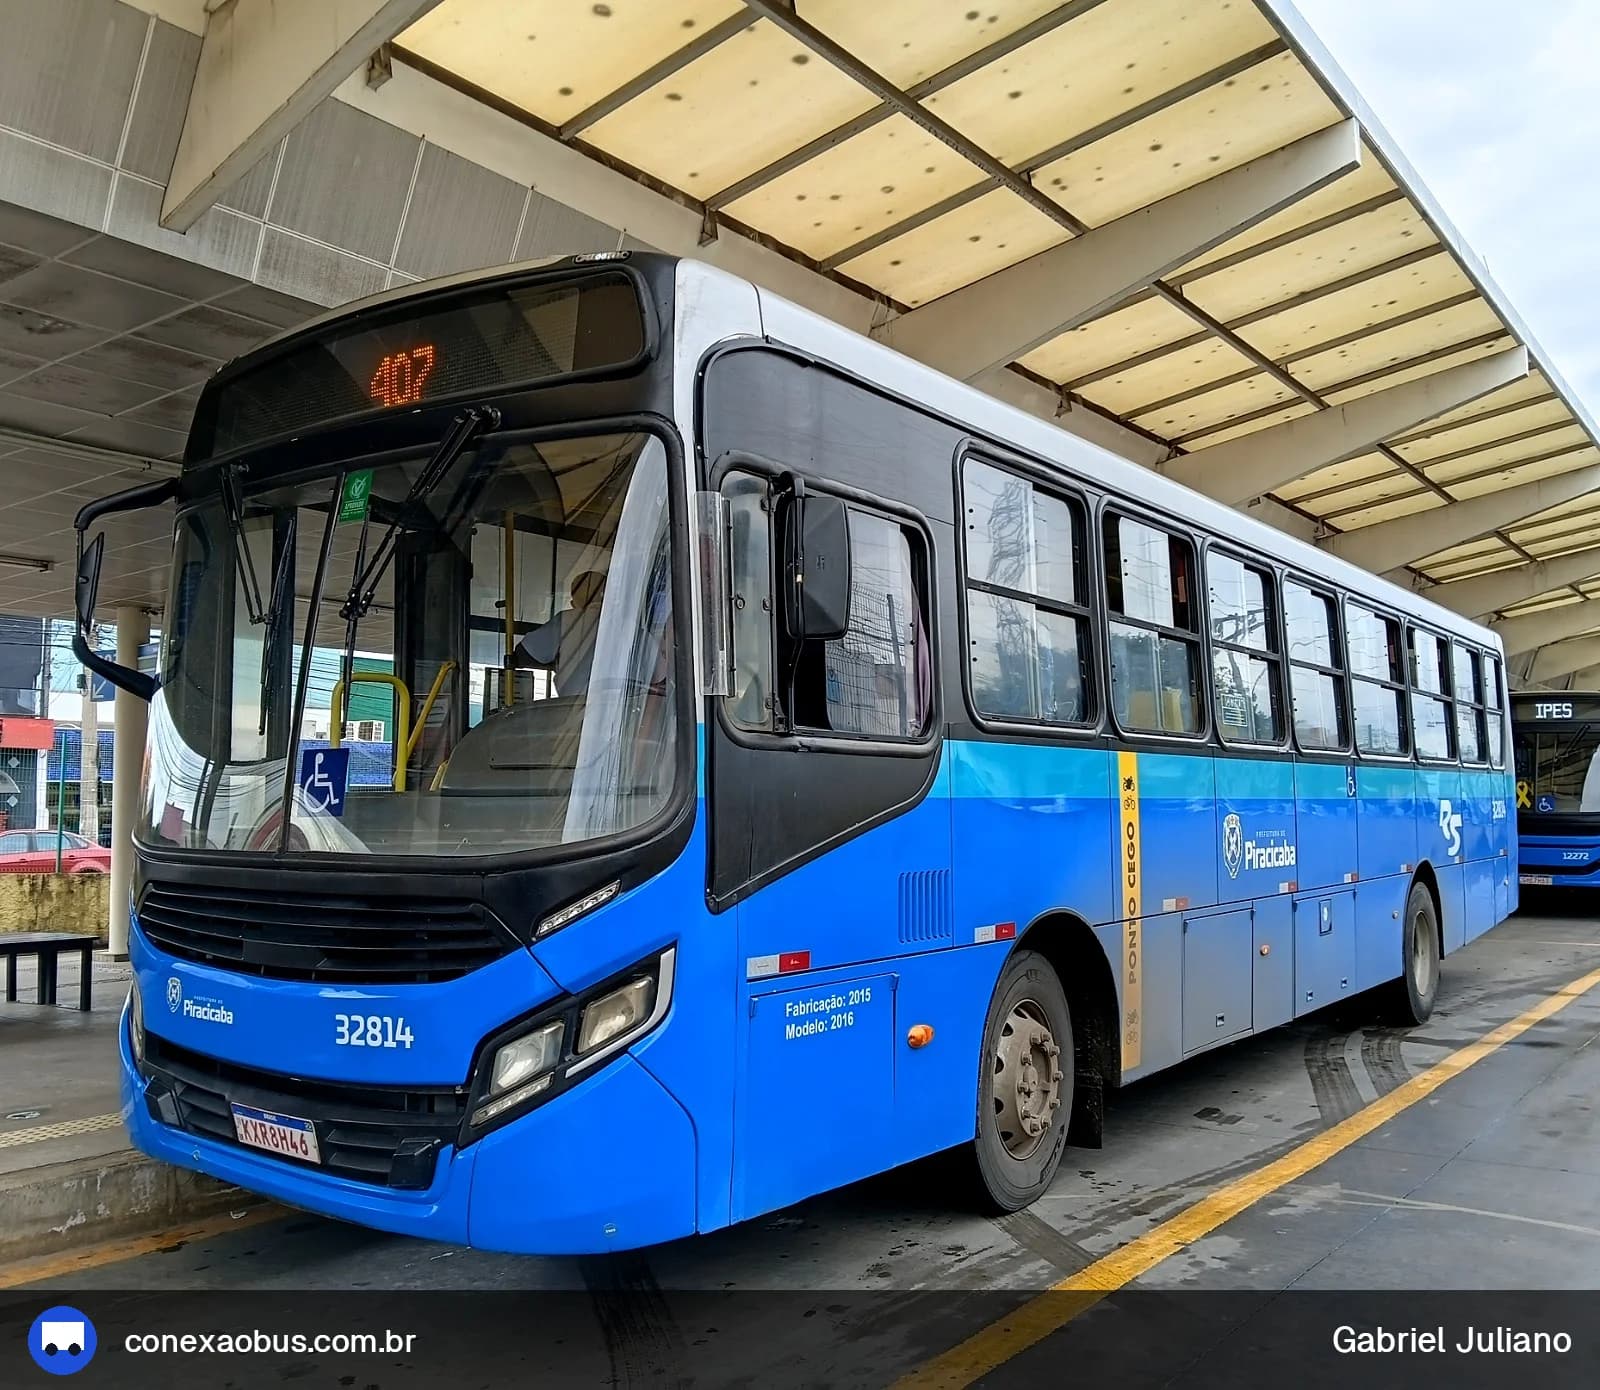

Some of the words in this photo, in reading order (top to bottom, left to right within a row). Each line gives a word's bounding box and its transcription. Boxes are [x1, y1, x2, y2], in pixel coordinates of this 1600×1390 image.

[370, 345, 434, 407] 407
[1535, 703, 1572, 719] IPES
[1126, 821, 1137, 889] CEGO
[1244, 839, 1296, 870] Piracicaba
[1562, 852, 1590, 861] 12272
[1127, 896, 1138, 985] PONTO
[183, 999, 234, 1025] Piracicaba
[785, 994, 847, 1018] Fabricação:
[848, 987, 872, 1005] 2015
[335, 1013, 415, 1049] 32814
[785, 1020, 829, 1041] Modelo:
[830, 1011, 855, 1031] 2016
[240, 1118, 310, 1156] KXR8H46
